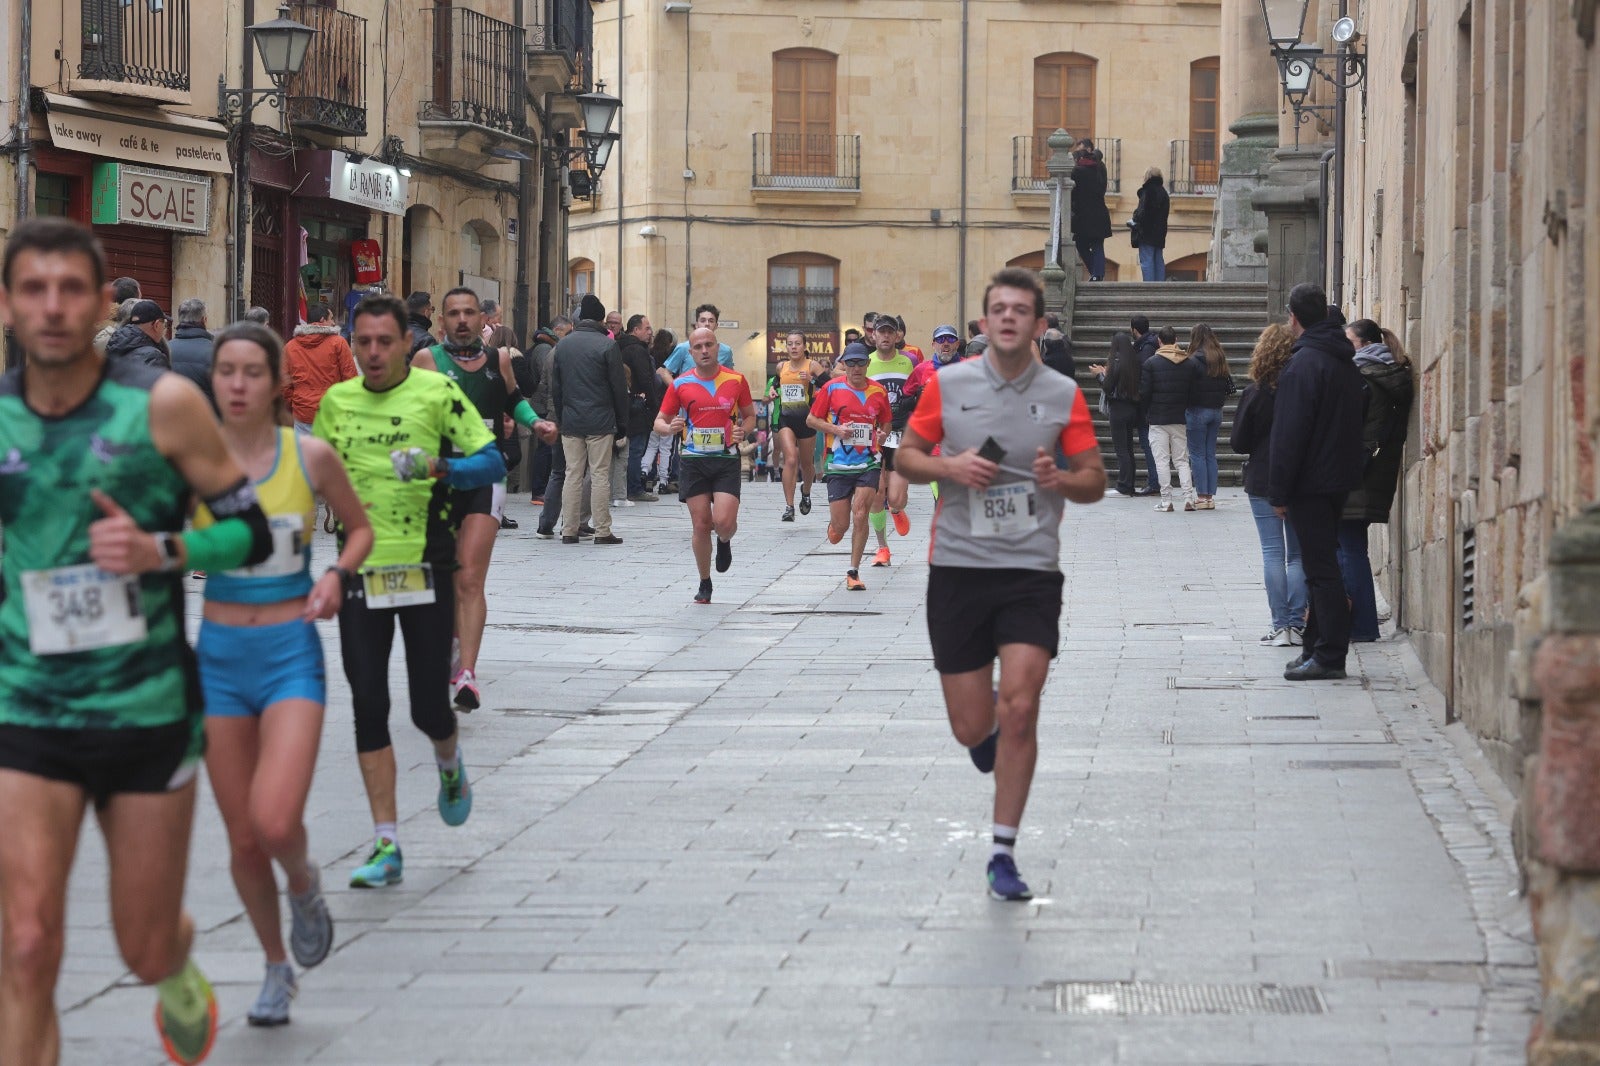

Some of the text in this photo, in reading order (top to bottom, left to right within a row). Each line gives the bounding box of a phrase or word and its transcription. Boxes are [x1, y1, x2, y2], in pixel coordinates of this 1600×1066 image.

[54, 123, 74, 139] take
[76, 130, 102, 147] away
[119, 135, 138, 149] café
[140, 139, 148, 151] &
[150, 141, 160, 153] te
[349, 169, 382, 200] LA RANITA
[130, 181, 196, 224] SCALE
[701, 434, 711, 444] 72
[984, 498, 1016, 518] 834
[381, 570, 408, 592] 192
[48, 586, 105, 624] 348
